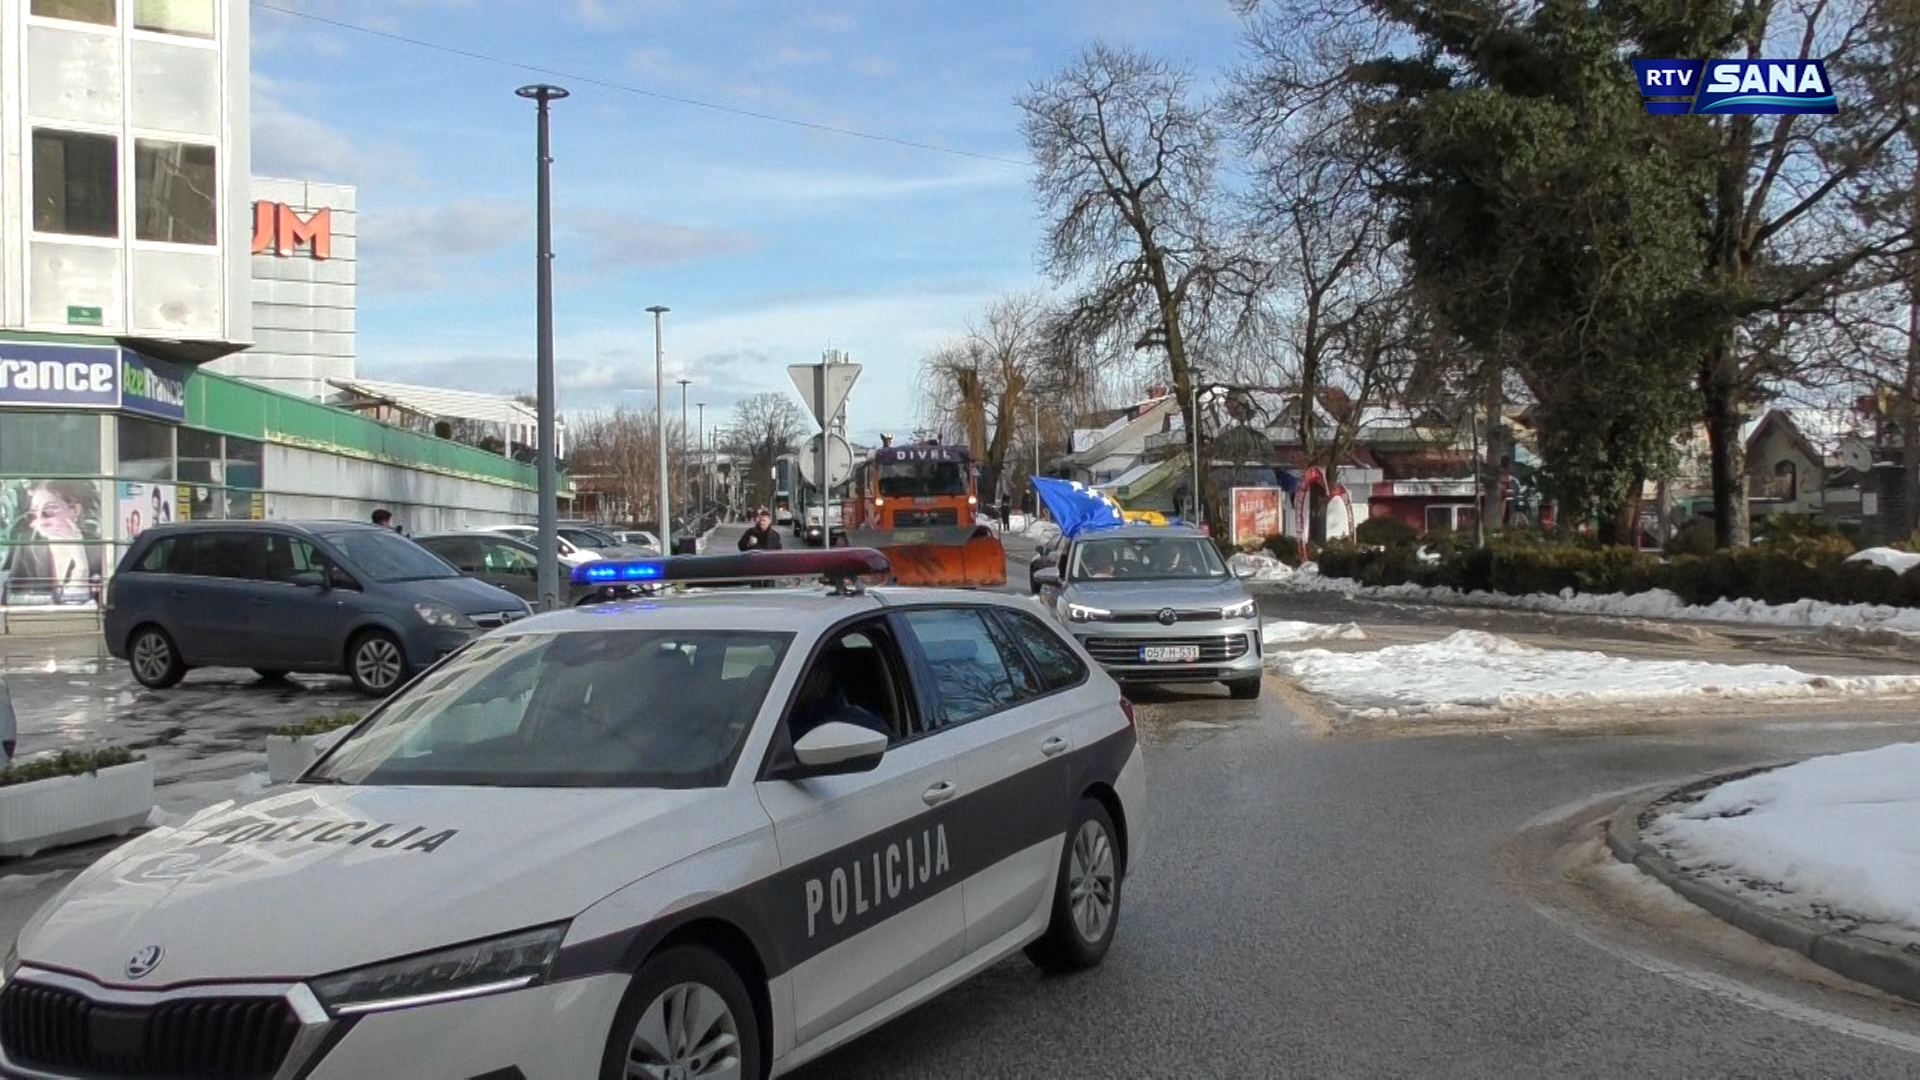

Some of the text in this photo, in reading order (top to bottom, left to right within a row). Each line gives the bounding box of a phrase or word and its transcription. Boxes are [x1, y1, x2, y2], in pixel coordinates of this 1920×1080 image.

[0, 356, 113, 392] rance
[187, 815, 460, 854] POLICIJA
[805, 823, 950, 938] POLICIJA
